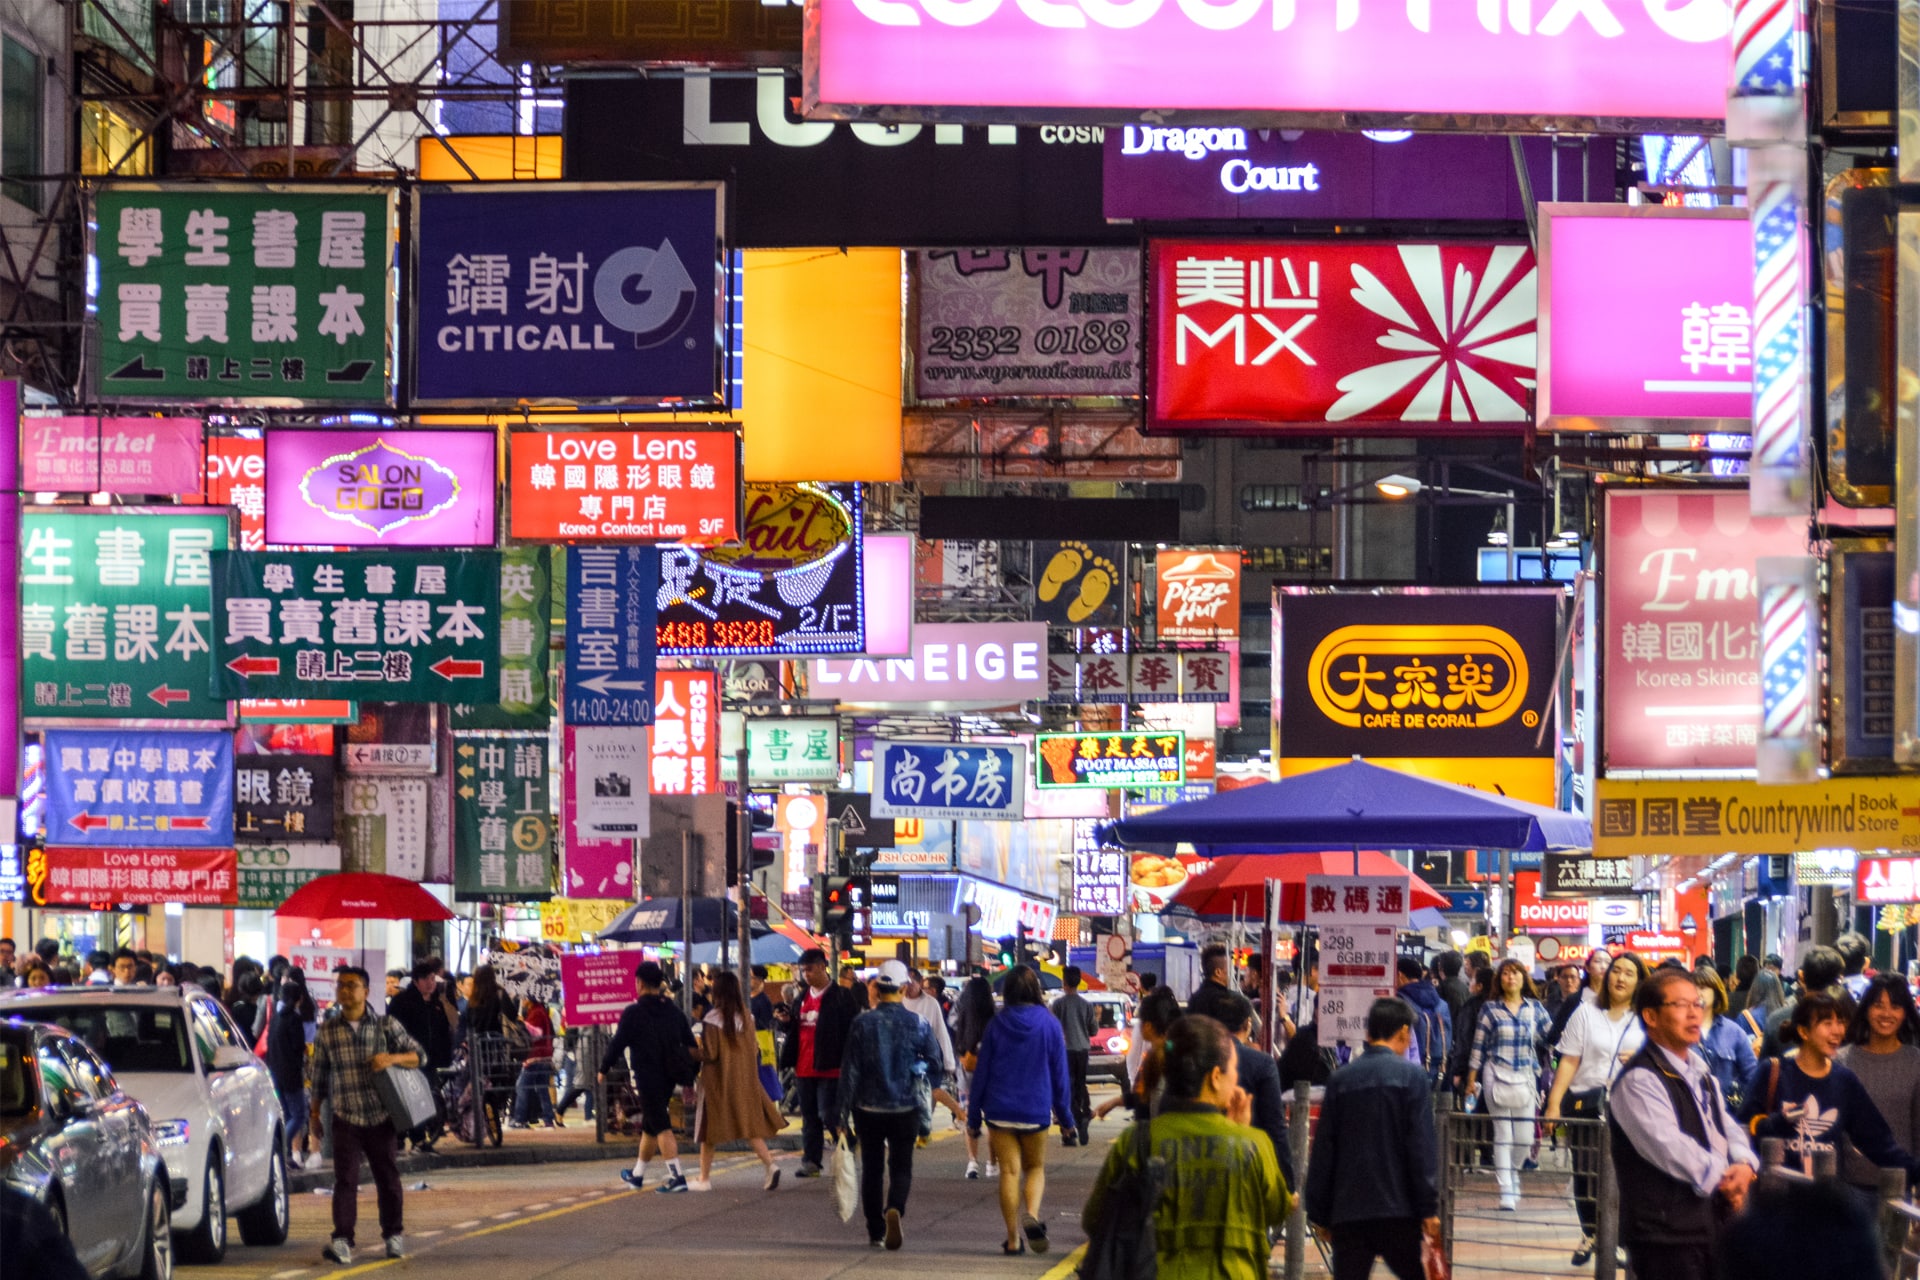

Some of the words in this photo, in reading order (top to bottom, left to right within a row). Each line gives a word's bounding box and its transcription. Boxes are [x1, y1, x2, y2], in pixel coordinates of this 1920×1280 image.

[1121, 126, 1247, 160] Dragon
[1221, 160, 1319, 193] Court
[117, 207, 366, 268] 學生書屋
[446, 252, 589, 315] 鐳射
[1176, 257, 1319, 308] 美心
[117, 284, 366, 344] 買賣課本
[437, 325, 615, 352] CITICALL
[929, 326, 1021, 361] 2332
[1034, 320, 1131, 354] 0188
[1176, 314, 1317, 366] MX
[187, 357, 305, 381] 請上二樓
[33, 426, 156, 457] Emarket
[547, 434, 617, 460] Love
[633, 434, 697, 460] Lens
[338, 464, 421, 485] SALON
[530, 463, 716, 490] 韓國隱形眼鏡
[336, 487, 423, 510] GOGO
[578, 495, 667, 520] 專門店
[559, 522, 596, 535] Korea
[601, 522, 654, 535] Contact
[659, 522, 687, 535] Lens
[698, 518, 725, 534] 3/F
[263, 563, 447, 595] 學生書屋
[1639, 547, 1758, 612] Em
[1163, 578, 1231, 611] Pizza
[225, 597, 486, 647] 買賣舊課本
[799, 603, 852, 632] 2/F
[1174, 597, 1227, 626] Hut
[713, 620, 774, 648] 3620
[296, 649, 412, 683] 請上二樓
[816, 643, 1039, 683] LANEIGE
[1636, 670, 1692, 687] Korea
[571, 698, 650, 722] 14:00-24:00
[1404, 713, 1425, 728] DE
[1426, 713, 1476, 728] CORAL
[1075, 758, 1112, 772] FOOT
[1113, 757, 1178, 771] MASSAGE
[236, 768, 314, 807] 眼鏡
[1859, 794, 1899, 811] Book
[1599, 797, 1722, 838] 國風堂
[1724, 792, 1855, 844] Countrywind
[1859, 814, 1899, 832] Store
[103, 851, 140, 867] Love
[143, 851, 177, 867] Lens
[50, 867, 231, 890] 韓國隱形眼鏡專門店
[122, 891, 156, 903] Korea
[157, 891, 197, 903] Contact
[199, 891, 221, 904] Lens
[1310, 885, 1403, 915] 數碼通
[1323, 935, 1355, 951] $298
[1322, 1000, 1345, 1015] $88
